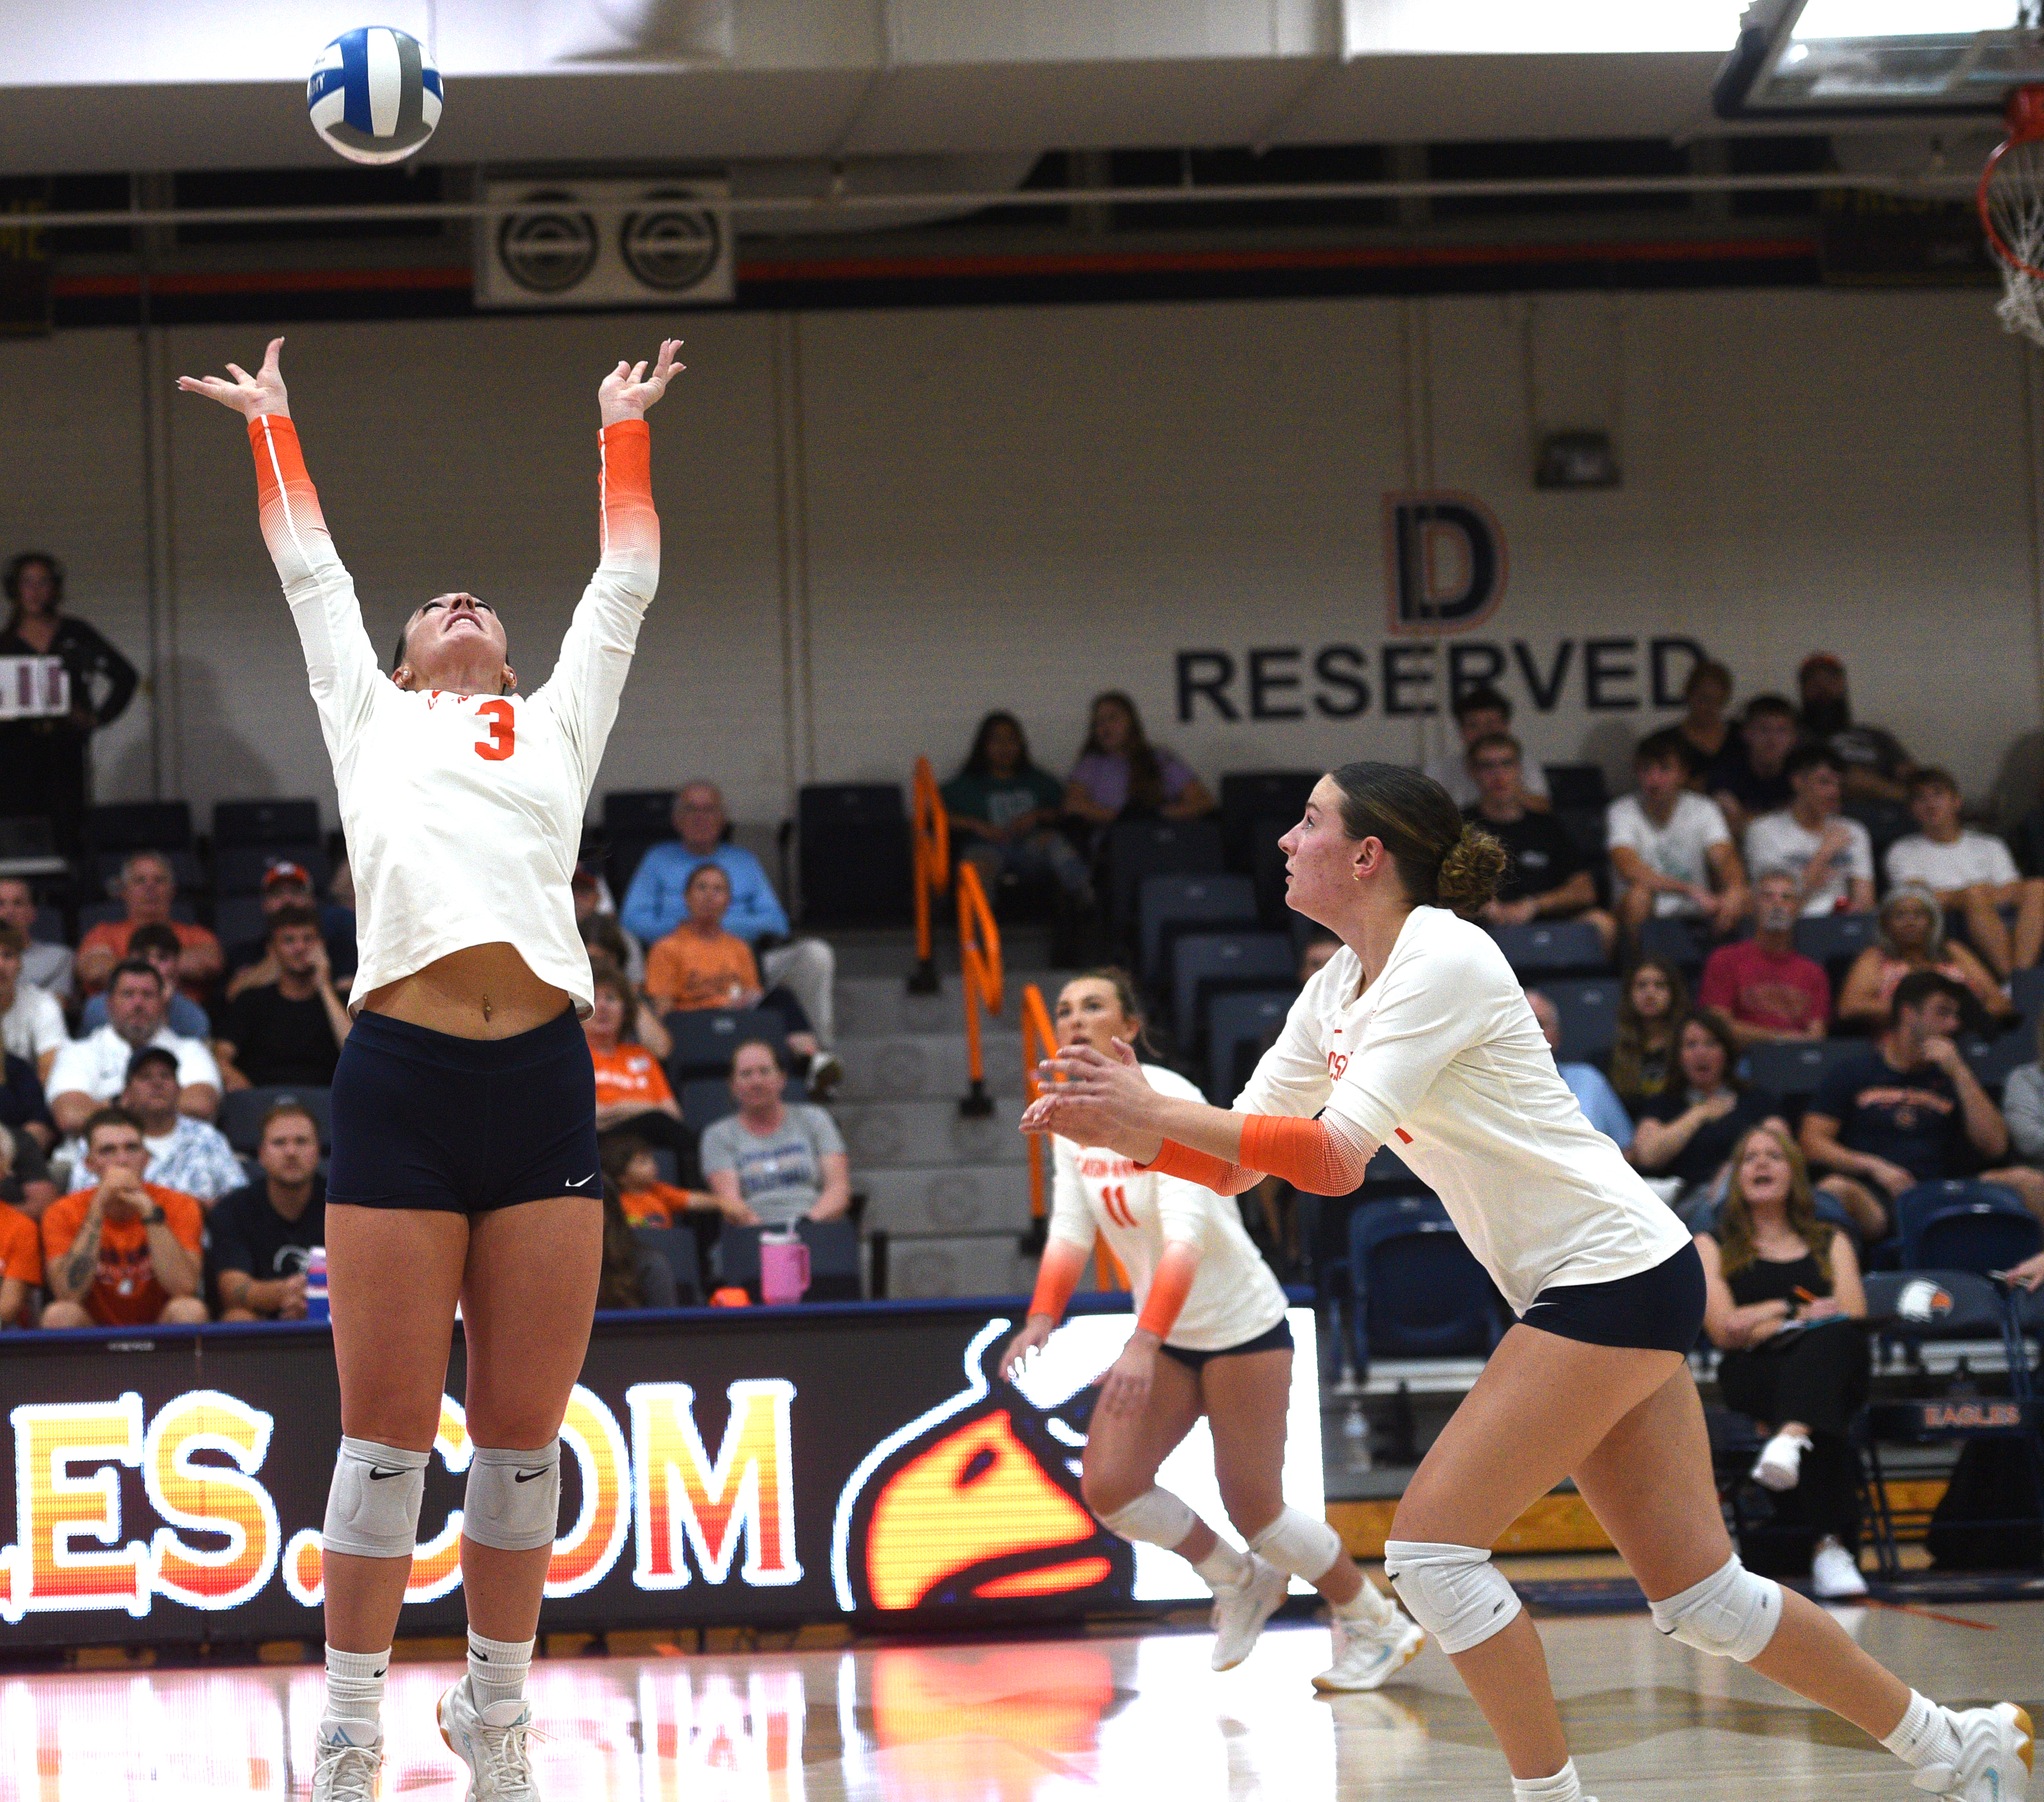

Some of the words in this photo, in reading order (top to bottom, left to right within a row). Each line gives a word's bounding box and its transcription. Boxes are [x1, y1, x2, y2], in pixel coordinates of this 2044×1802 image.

[1174, 635, 1709, 724] RESERVED
[475, 699, 514, 761] 3
[1102, 1186, 1137, 1229] 11
[1923, 1404, 2020, 1428] EAGLES
